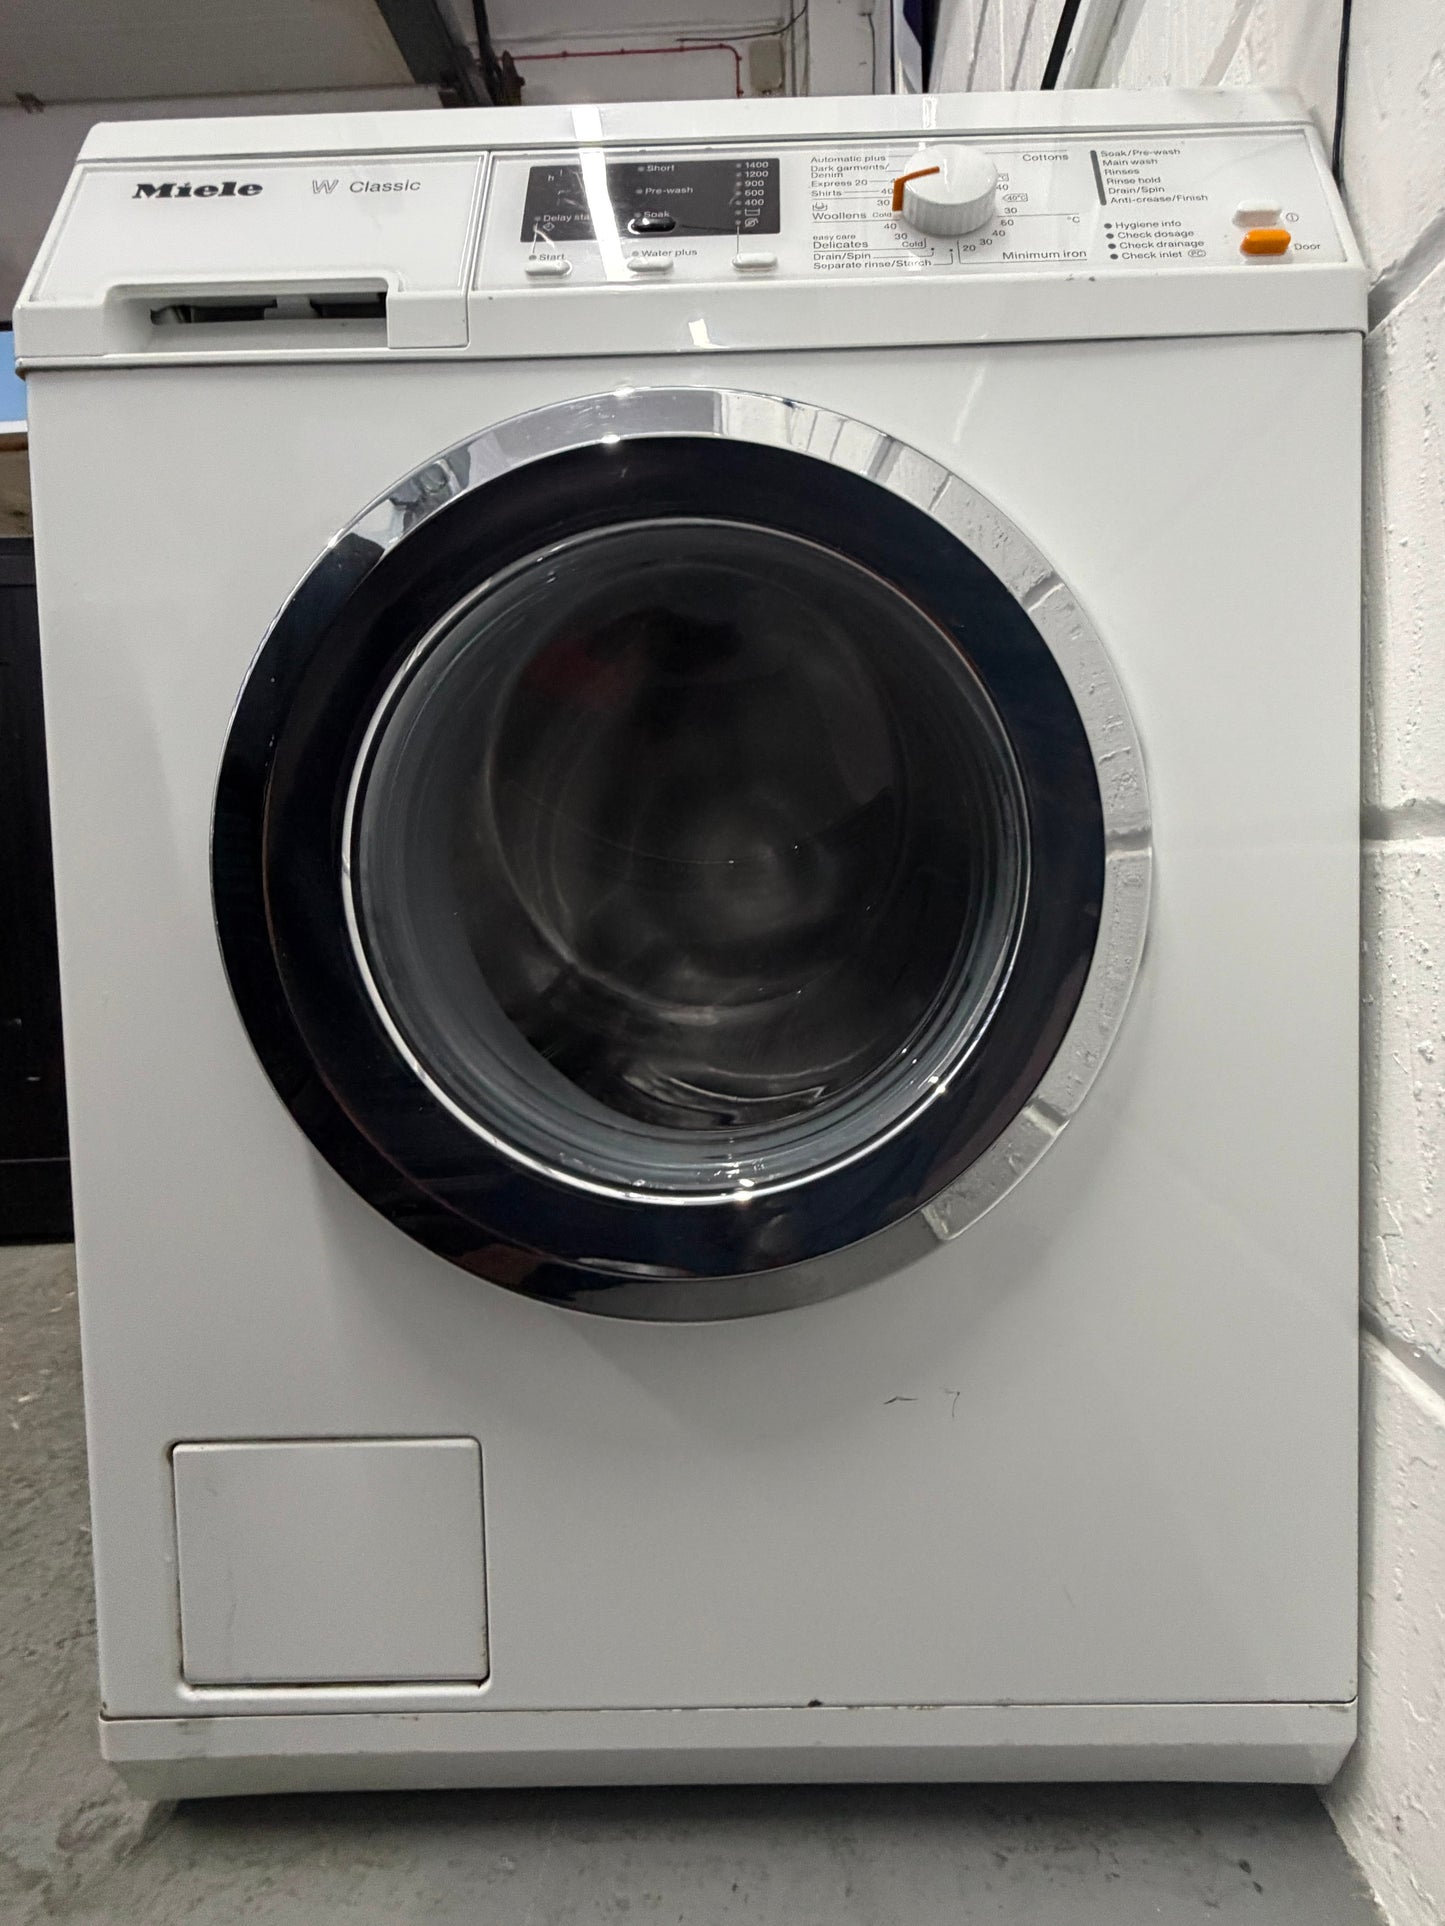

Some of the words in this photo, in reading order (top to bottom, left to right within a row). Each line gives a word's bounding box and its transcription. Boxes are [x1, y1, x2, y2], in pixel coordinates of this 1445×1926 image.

[1022, 153, 1069, 162] Cottons
[1100, 149, 1181, 158] Soak/Pre-wash
[810, 155, 862, 164] Automatic
[864, 155, 886, 164] plus
[646, 164, 675, 172] Short
[744, 161, 769, 169] 1400
[836, 163, 890, 173] garments/
[744, 170, 769, 178] 1200
[1104, 168, 1140, 176] Rinses
[744, 179, 765, 187] 900
[811, 180, 852, 189] Express
[1106, 177, 1136, 185] Rinse
[1138, 176, 1161, 184] hold
[131, 181, 264, 199] Miele
[349, 178, 422, 194] Classic
[1108, 186, 1165, 195] Drain/Spin
[644, 187, 694, 196] Pre-wash
[744, 188, 765, 196] 600
[744, 198, 765, 206] 400
[1110, 194, 1209, 204] Anti-crease/Finish
[543, 214, 572, 223] Delay
[643, 210, 671, 218] Soak
[812, 212, 867, 220] Woollens
[1115, 221, 1159, 230] Hygiene
[813, 234, 834, 242] easy
[836, 233, 856, 241] care
[1117, 231, 1152, 239] Check
[1155, 230, 1195, 239] dosage
[813, 241, 869, 249] Delicates
[901, 240, 923, 248] Cold
[980, 238, 993, 246] 30
[1119, 241, 1154, 250] Check
[1156, 240, 1205, 249] drainage
[962, 244, 976, 252] 20
[1294, 243, 1321, 251] Door
[539, 253, 566, 261] Start
[674, 249, 698, 258] plus
[813, 252, 871, 261] Drain/Spin
[1002, 250, 1062, 260] Minimum
[1063, 249, 1087, 258] iron
[1121, 251, 1156, 260] Check
[1159, 250, 1183, 258] inlet
[813, 261, 862, 271] Separate
[864, 260, 932, 269] rinse/Starch
